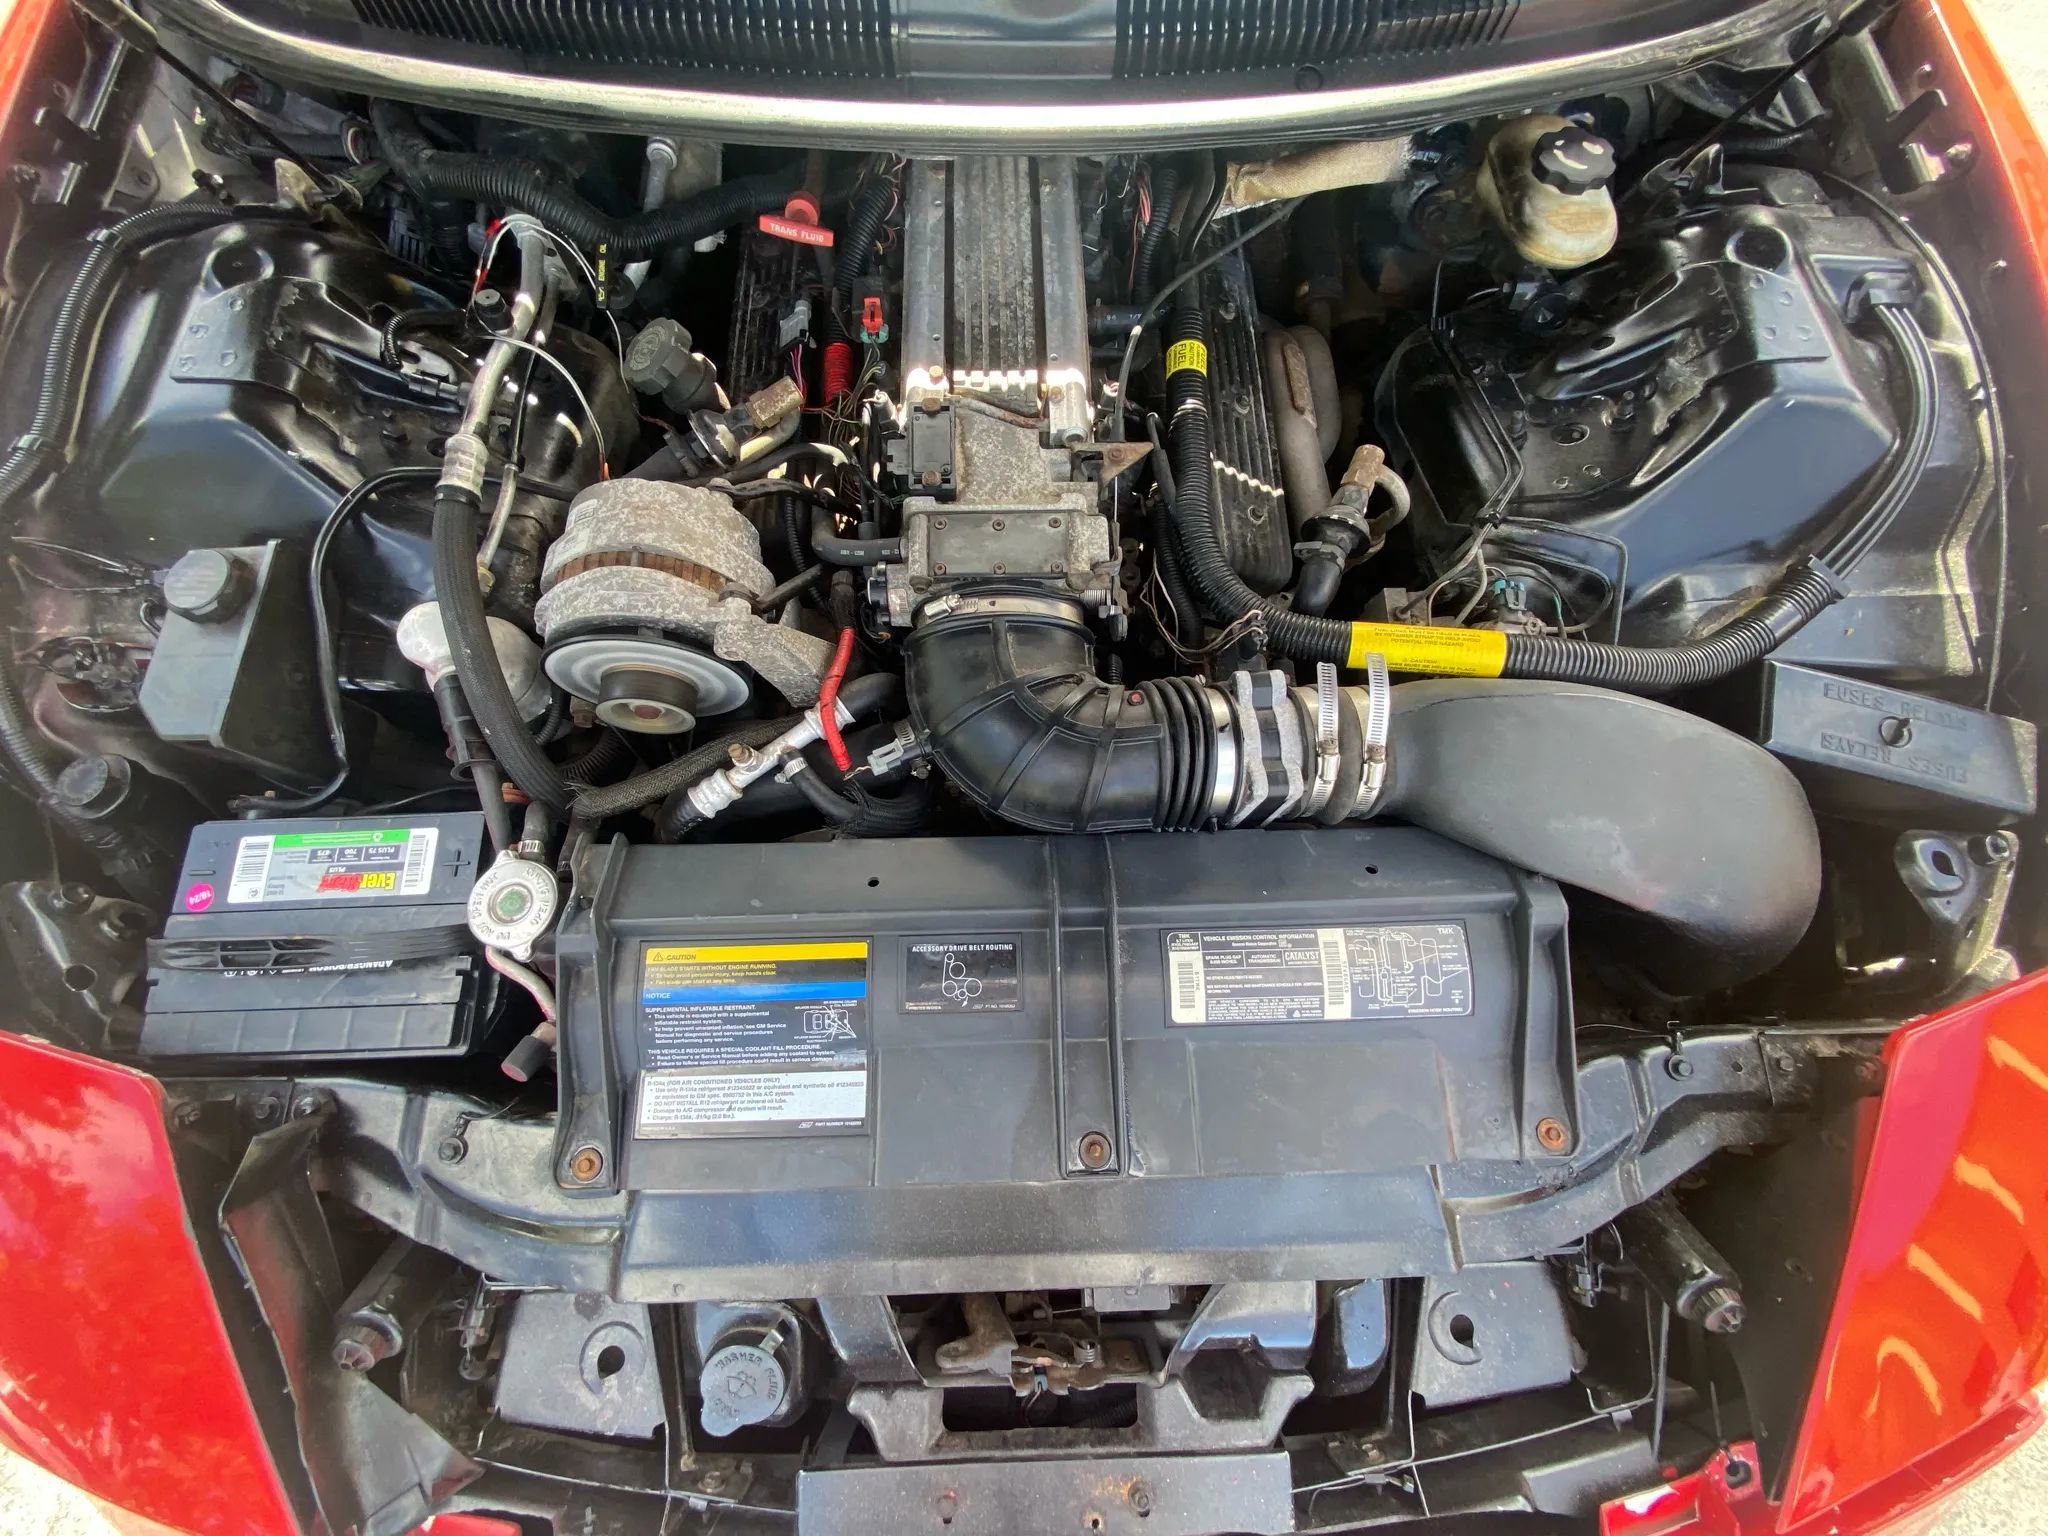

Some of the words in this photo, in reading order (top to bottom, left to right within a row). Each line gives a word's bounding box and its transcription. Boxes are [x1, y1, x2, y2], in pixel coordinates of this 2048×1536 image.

[770, 223, 797, 236] TRANS
[801, 231, 824, 242] FLUID
[599, 244, 607, 254] OIL
[598, 259, 606, 281] ENGINE
[1178, 344, 1186, 367] FUEL
[1824, 683, 1884, 708] FUSES
[1900, 703, 1968, 727] RELAYS
[1822, 733, 1891, 763] RELAYS
[1907, 757, 1968, 783] FUSES
[316, 872, 396, 893] EverStart
[912, 944, 949, 952] ACCESSORY
[1284, 952, 1320, 961] CATALYST
